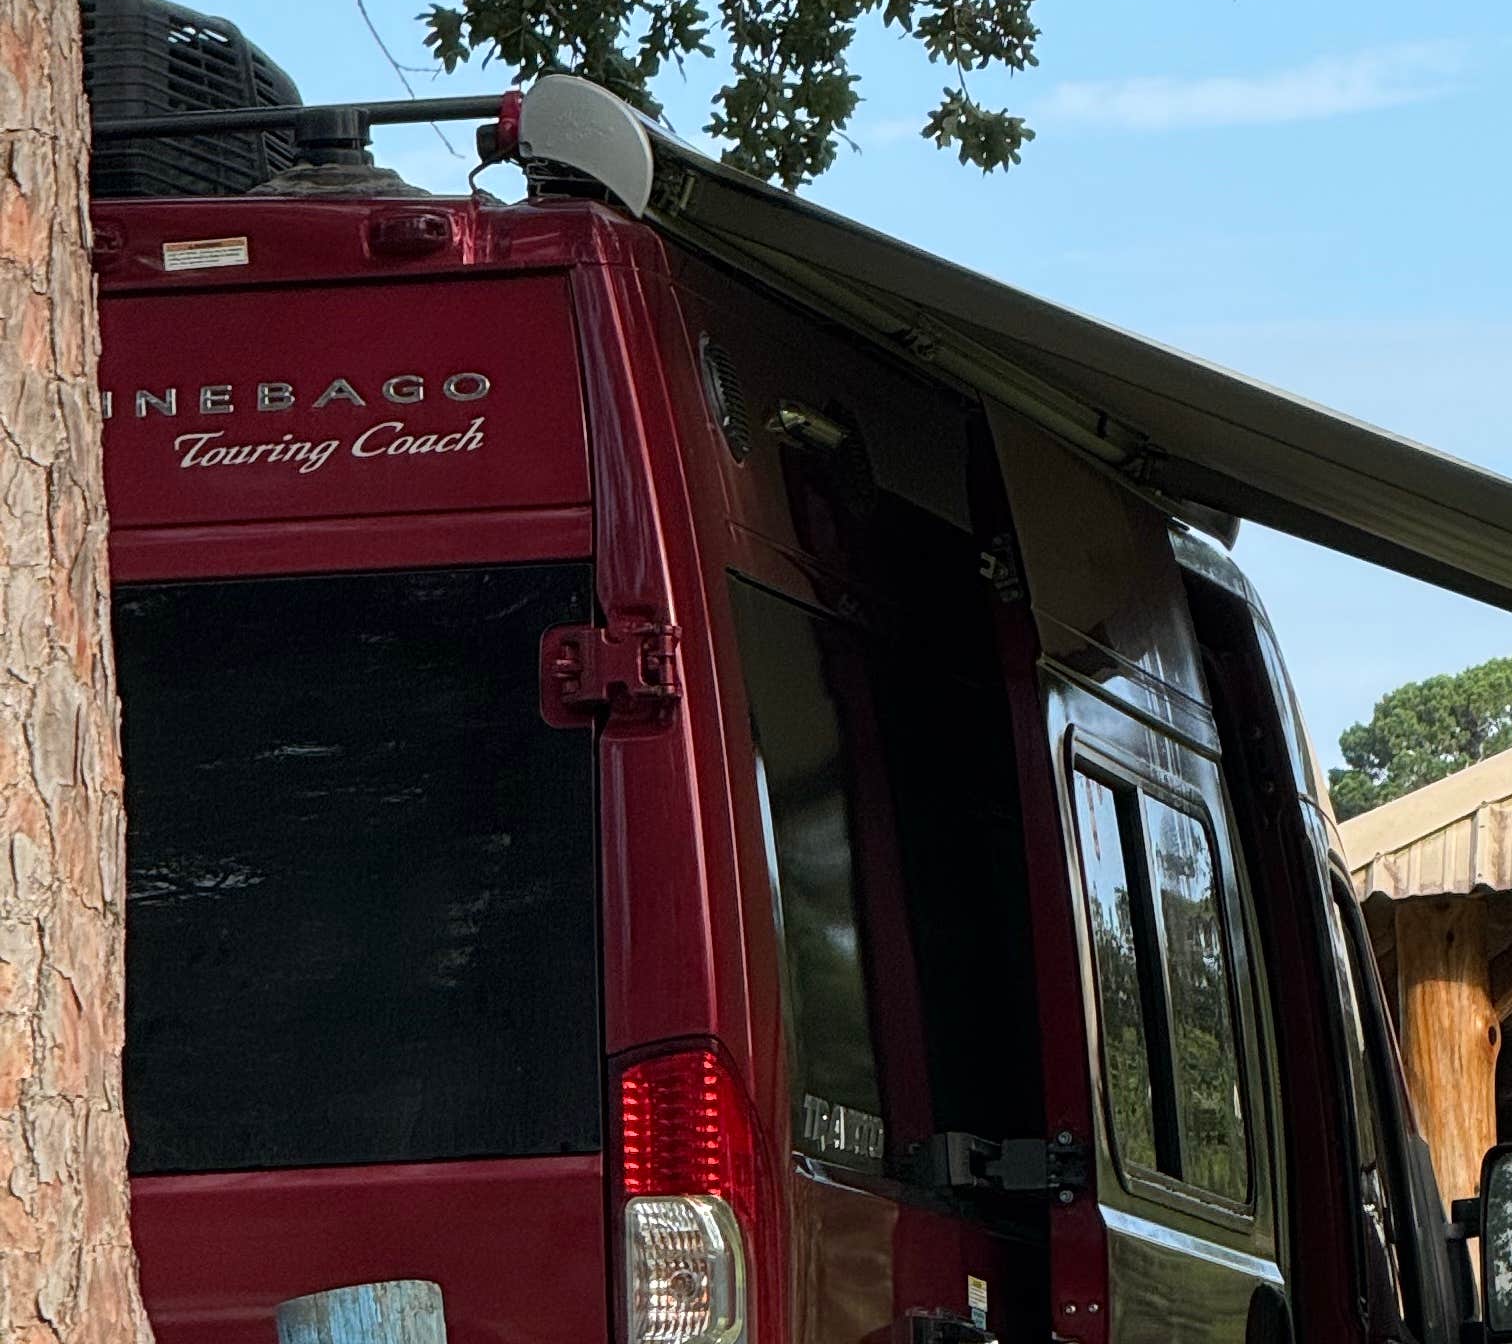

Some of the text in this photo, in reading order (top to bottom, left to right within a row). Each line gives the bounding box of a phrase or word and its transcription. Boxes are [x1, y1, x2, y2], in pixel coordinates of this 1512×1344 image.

[102, 372, 491, 419] NEBAGO
[174, 416, 486, 474] Touring Coach
